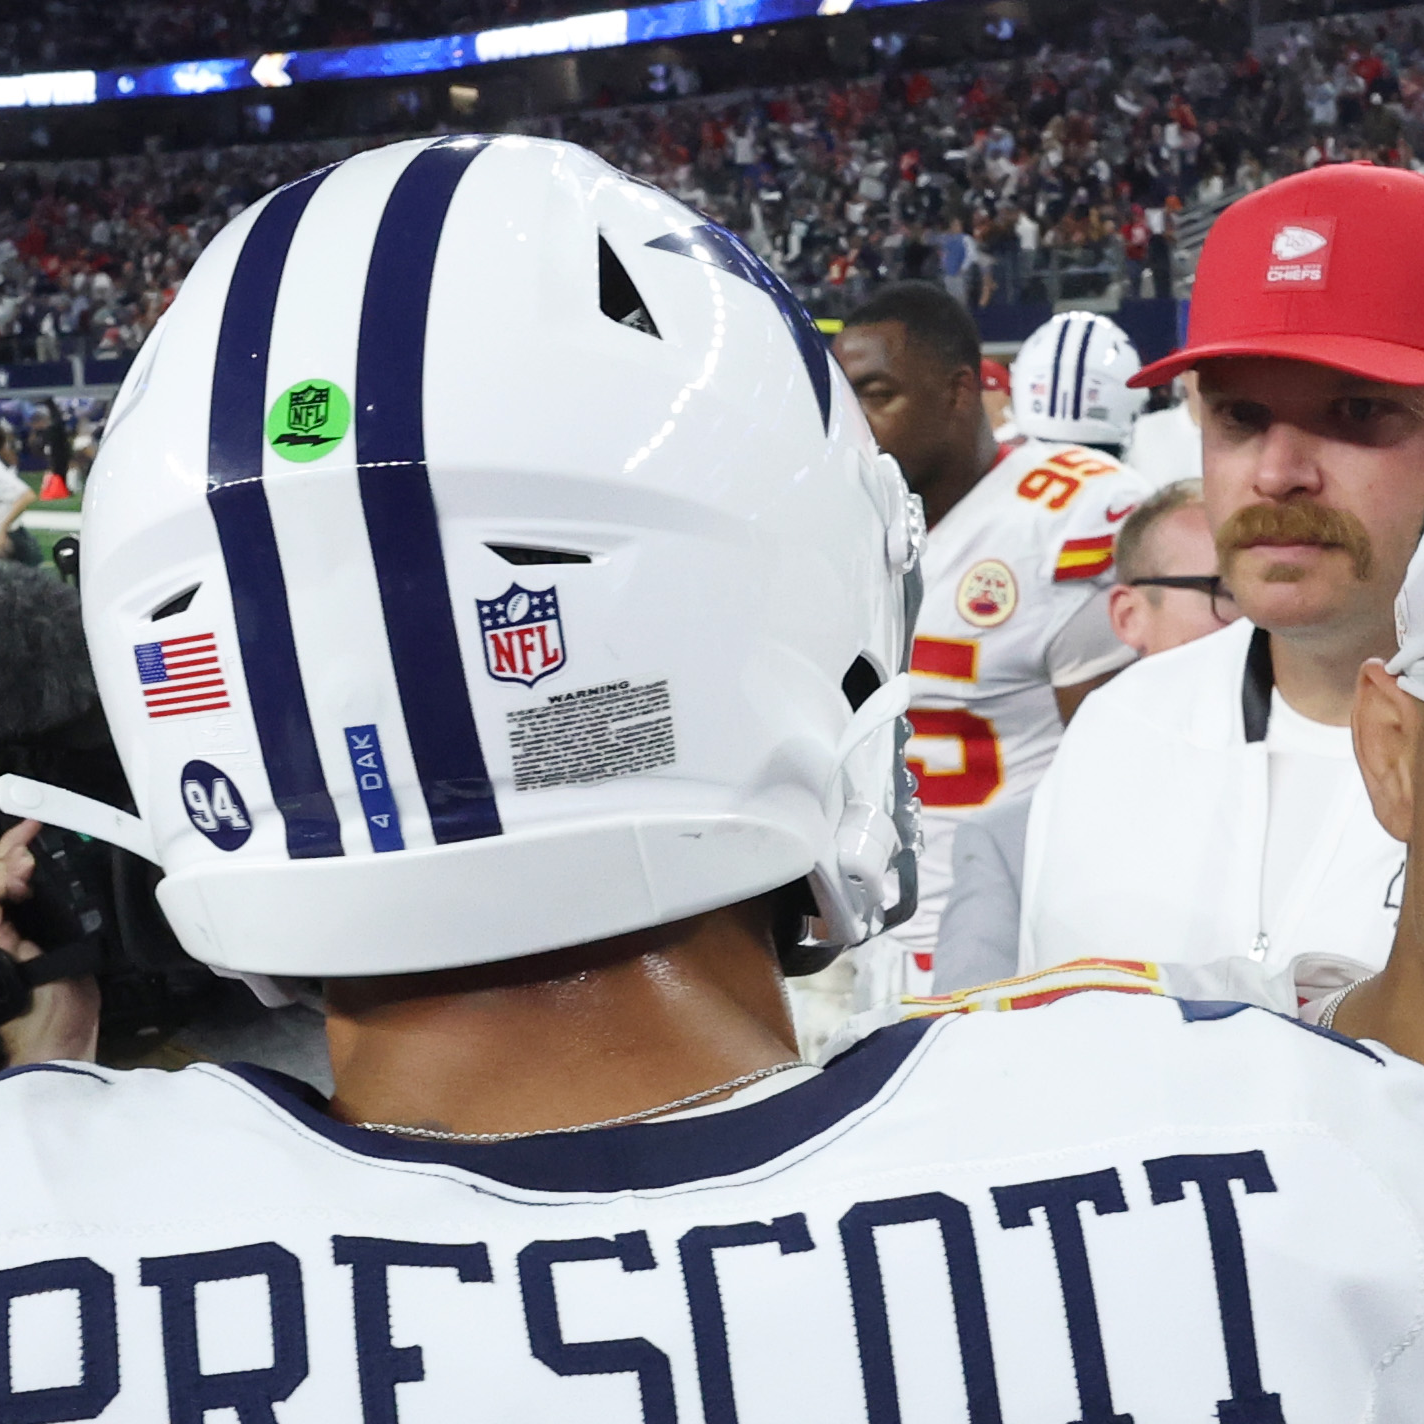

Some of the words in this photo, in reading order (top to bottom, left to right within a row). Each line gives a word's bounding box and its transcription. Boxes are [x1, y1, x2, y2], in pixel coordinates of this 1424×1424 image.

[1267, 270, 1322, 281] CHIEFS
[291, 404, 327, 428] NFL
[488, 624, 561, 678] NFL
[547, 680, 631, 704] WARNING
[350, 733, 384, 791] DAK
[183, 776, 251, 833] 94
